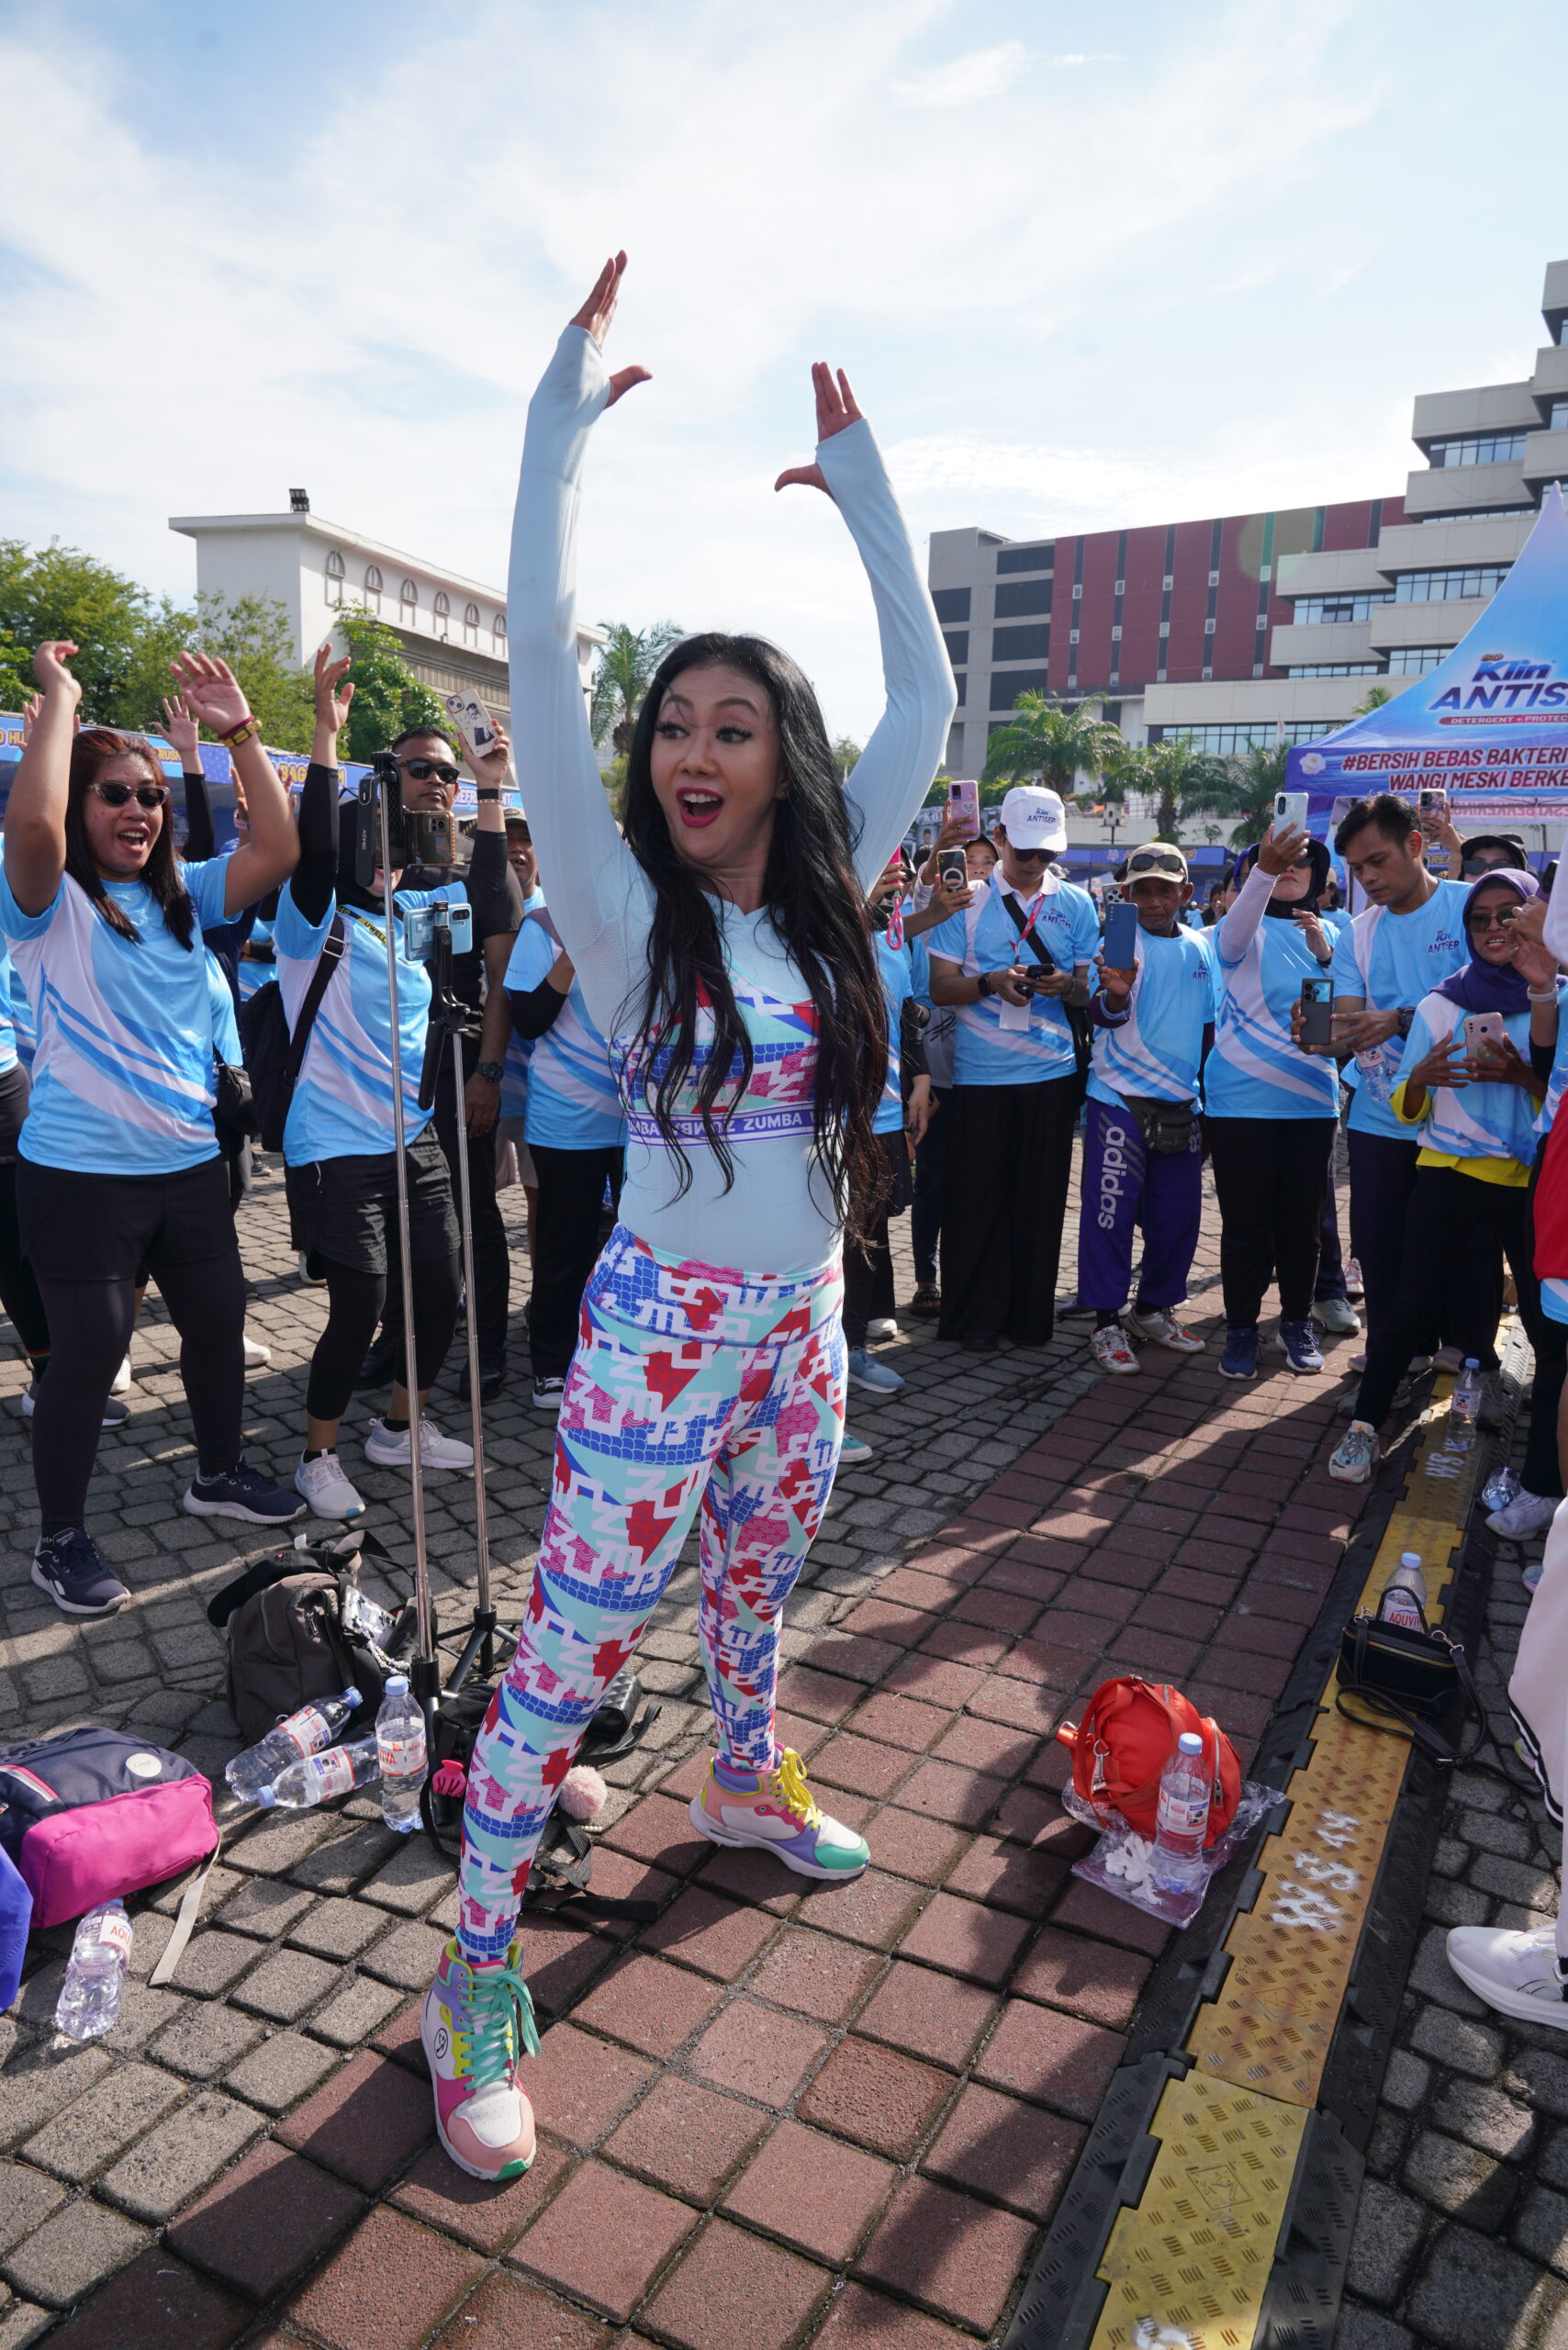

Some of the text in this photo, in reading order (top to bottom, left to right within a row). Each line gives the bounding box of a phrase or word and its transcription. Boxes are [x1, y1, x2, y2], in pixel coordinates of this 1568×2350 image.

[1472, 659, 1552, 682] Klin
[1428, 682, 1568, 710] ANTIS
[1450, 716, 1514, 725] DETERGENT
[1525, 714, 1568, 722] PROTEC
[1342, 751, 1420, 771] #BERSIH
[1423, 748, 1484, 767] BEBAS
[1389, 768, 1568, 791] WANGI MESKI BERKE
[743, 1111, 802, 1131] ZUMBA
[1097, 1125, 1127, 1230] adidas
